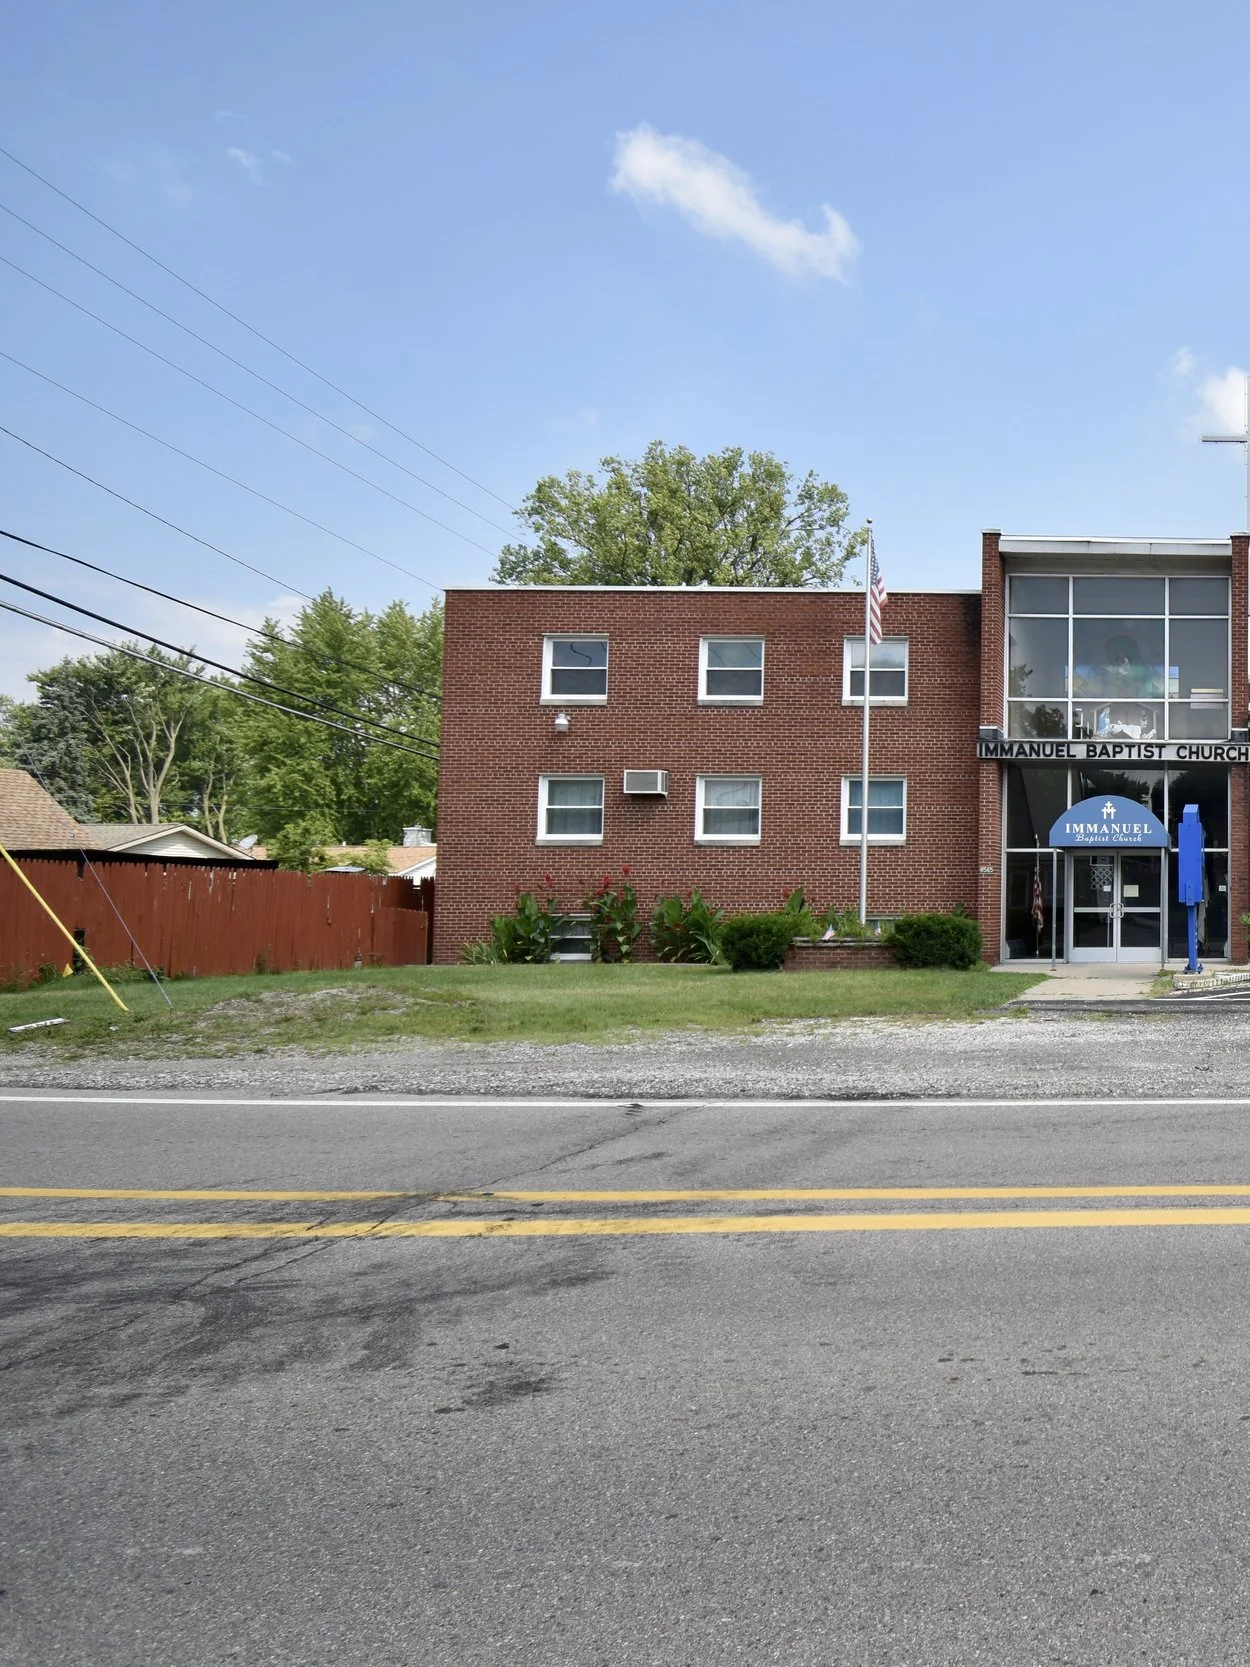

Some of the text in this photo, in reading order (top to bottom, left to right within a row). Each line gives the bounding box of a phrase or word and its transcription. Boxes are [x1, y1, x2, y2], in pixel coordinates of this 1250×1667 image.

[979, 743, 1250, 761] IMMANUEL BAPTIST CHURCH
[1065, 823, 1152, 834] IMMANUEL
[1075, 833, 1142, 844] Baptist Church
